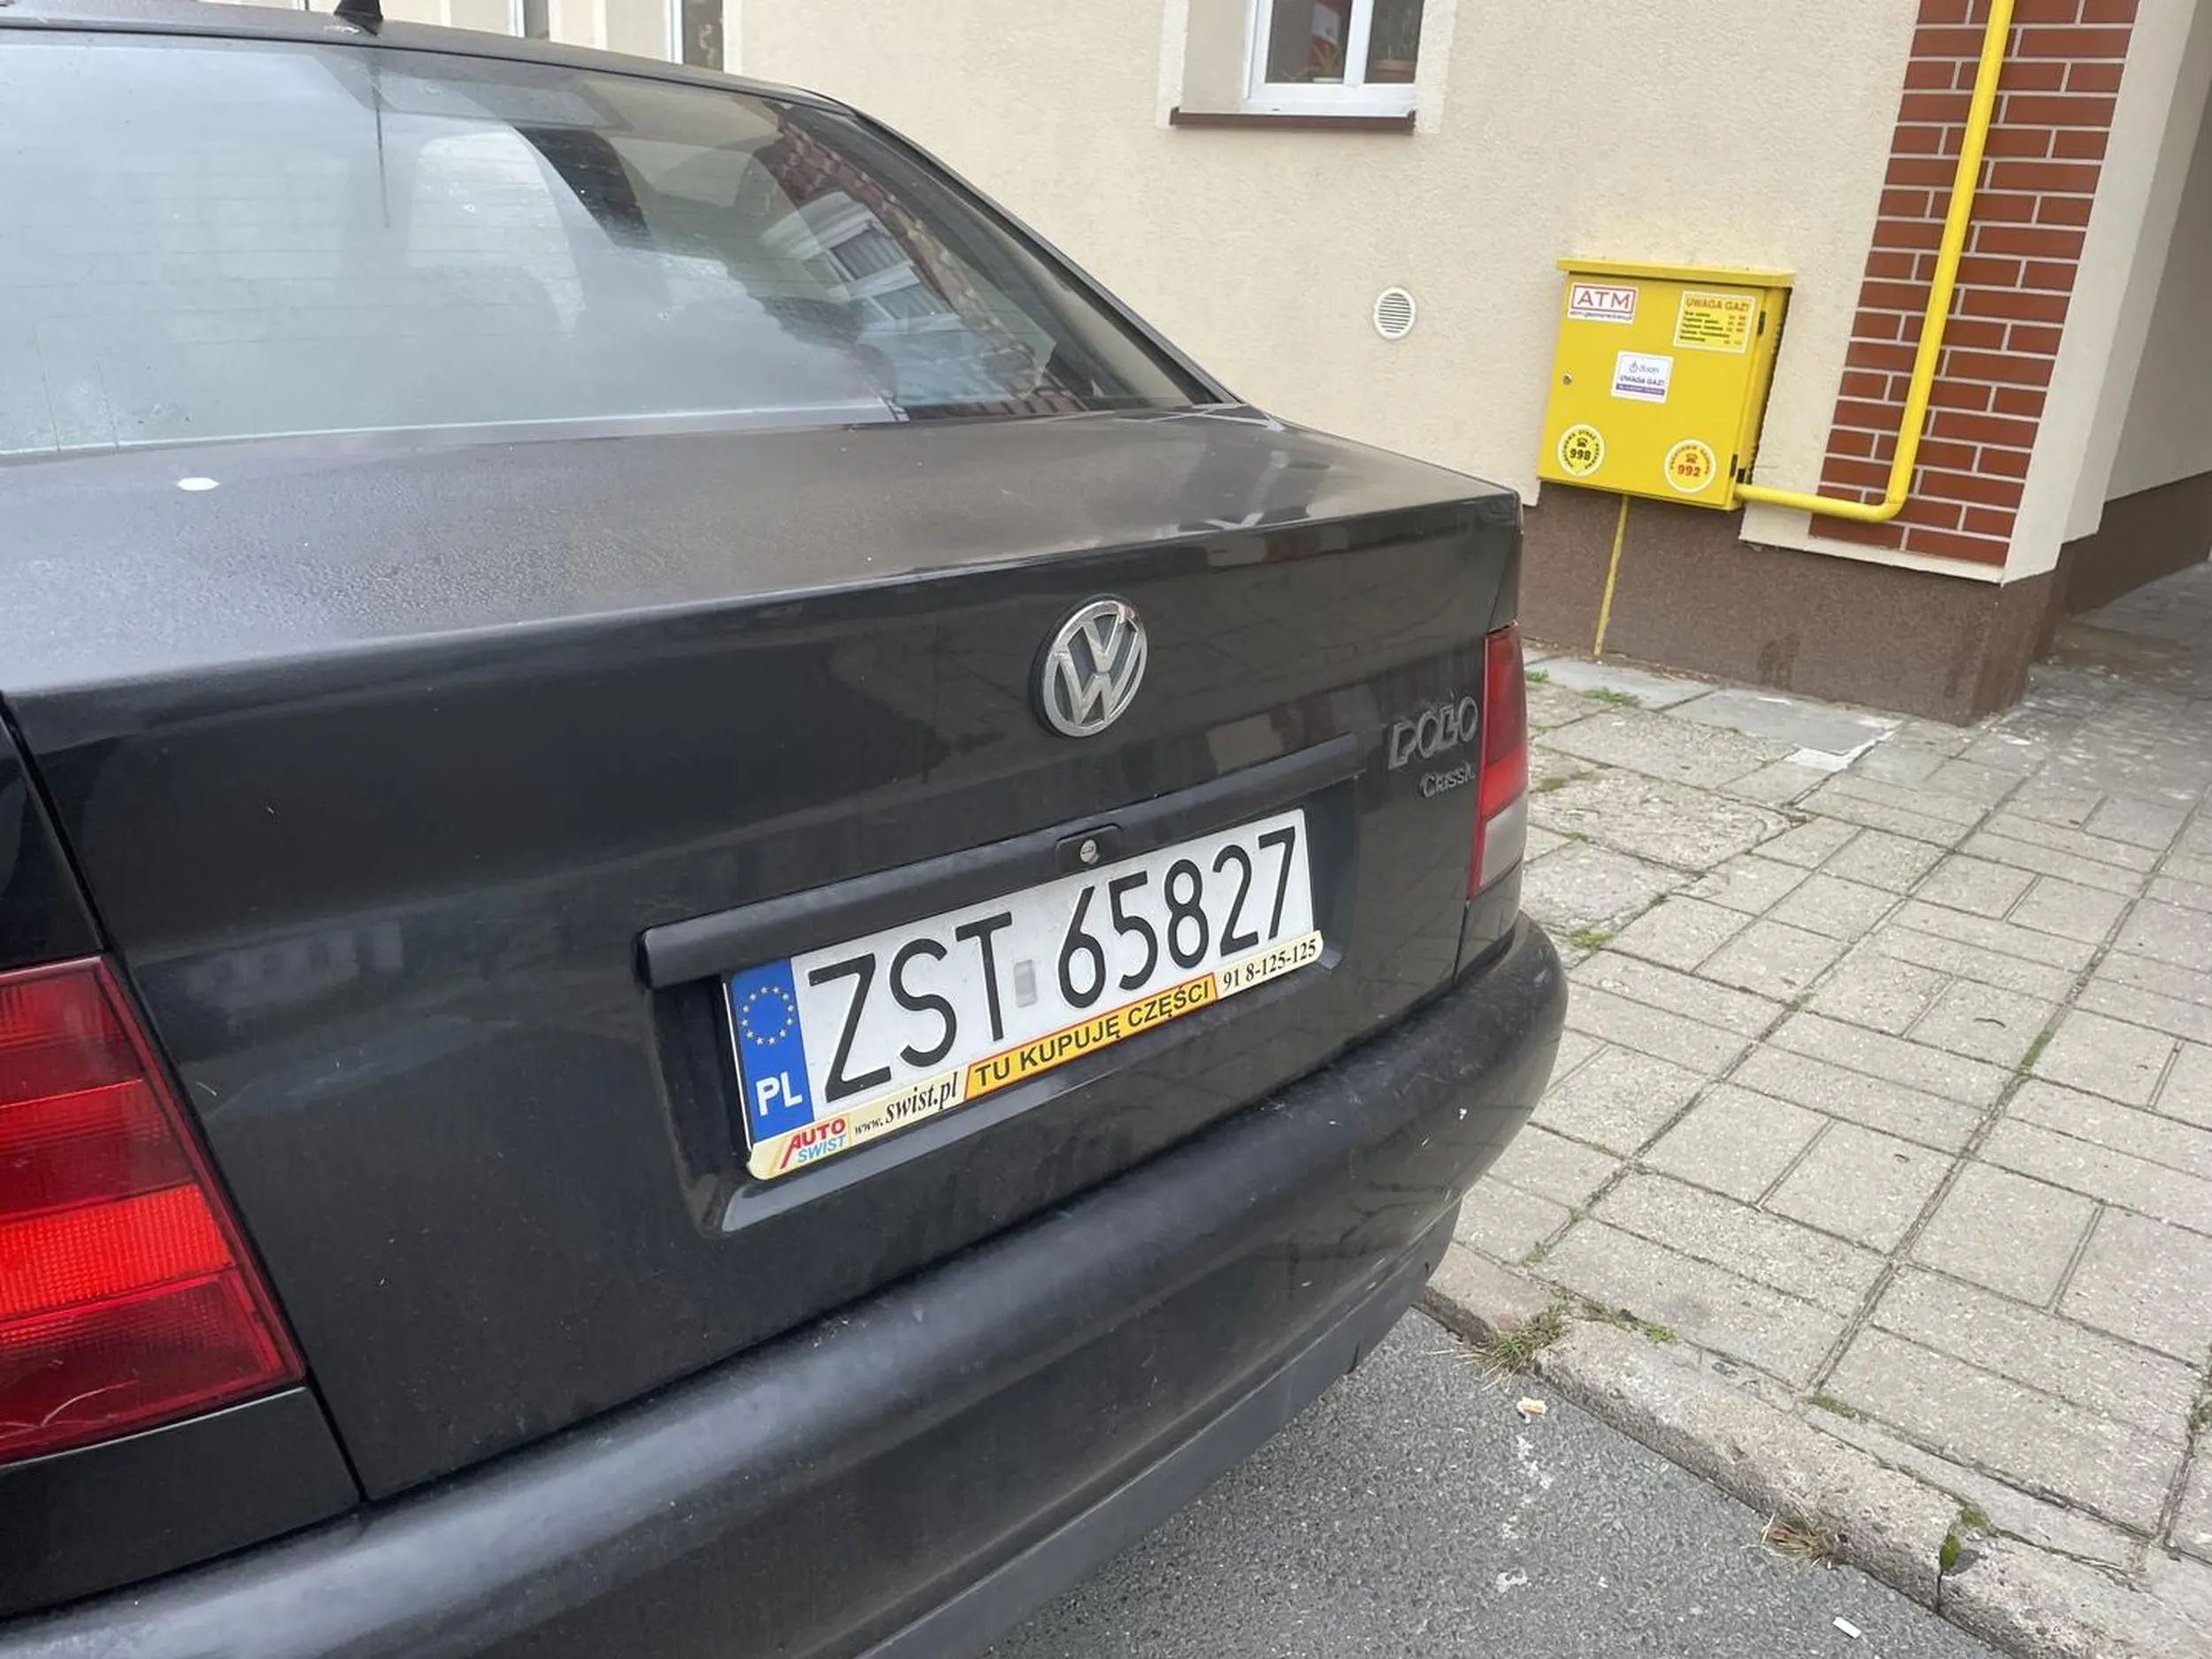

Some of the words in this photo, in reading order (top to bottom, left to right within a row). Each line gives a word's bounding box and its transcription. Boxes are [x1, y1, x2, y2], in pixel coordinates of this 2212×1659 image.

[1577, 290, 1631, 309] ATM
[1686, 297, 1722, 310] UWAGA
[1570, 448, 1591, 460] 998
[1678, 465, 1701, 478] 992
[1388, 695, 1479, 770] POLO
[808, 911, 1012, 1103] ZST
[1058, 826, 1296, 1009] 65827
[1223, 969, 1240, 990] 91
[1246, 941, 1317, 983] 8-125-125
[975, 1056, 1010, 1087] TU
[1020, 1015, 1121, 1071] KUPUJĘ
[1128, 980, 1210, 1028] CZĘŚCI
[756, 1071, 803, 1117] PL
[780, 1118, 846, 1169] AUTO
[797, 1133, 847, 1164] SWIST
